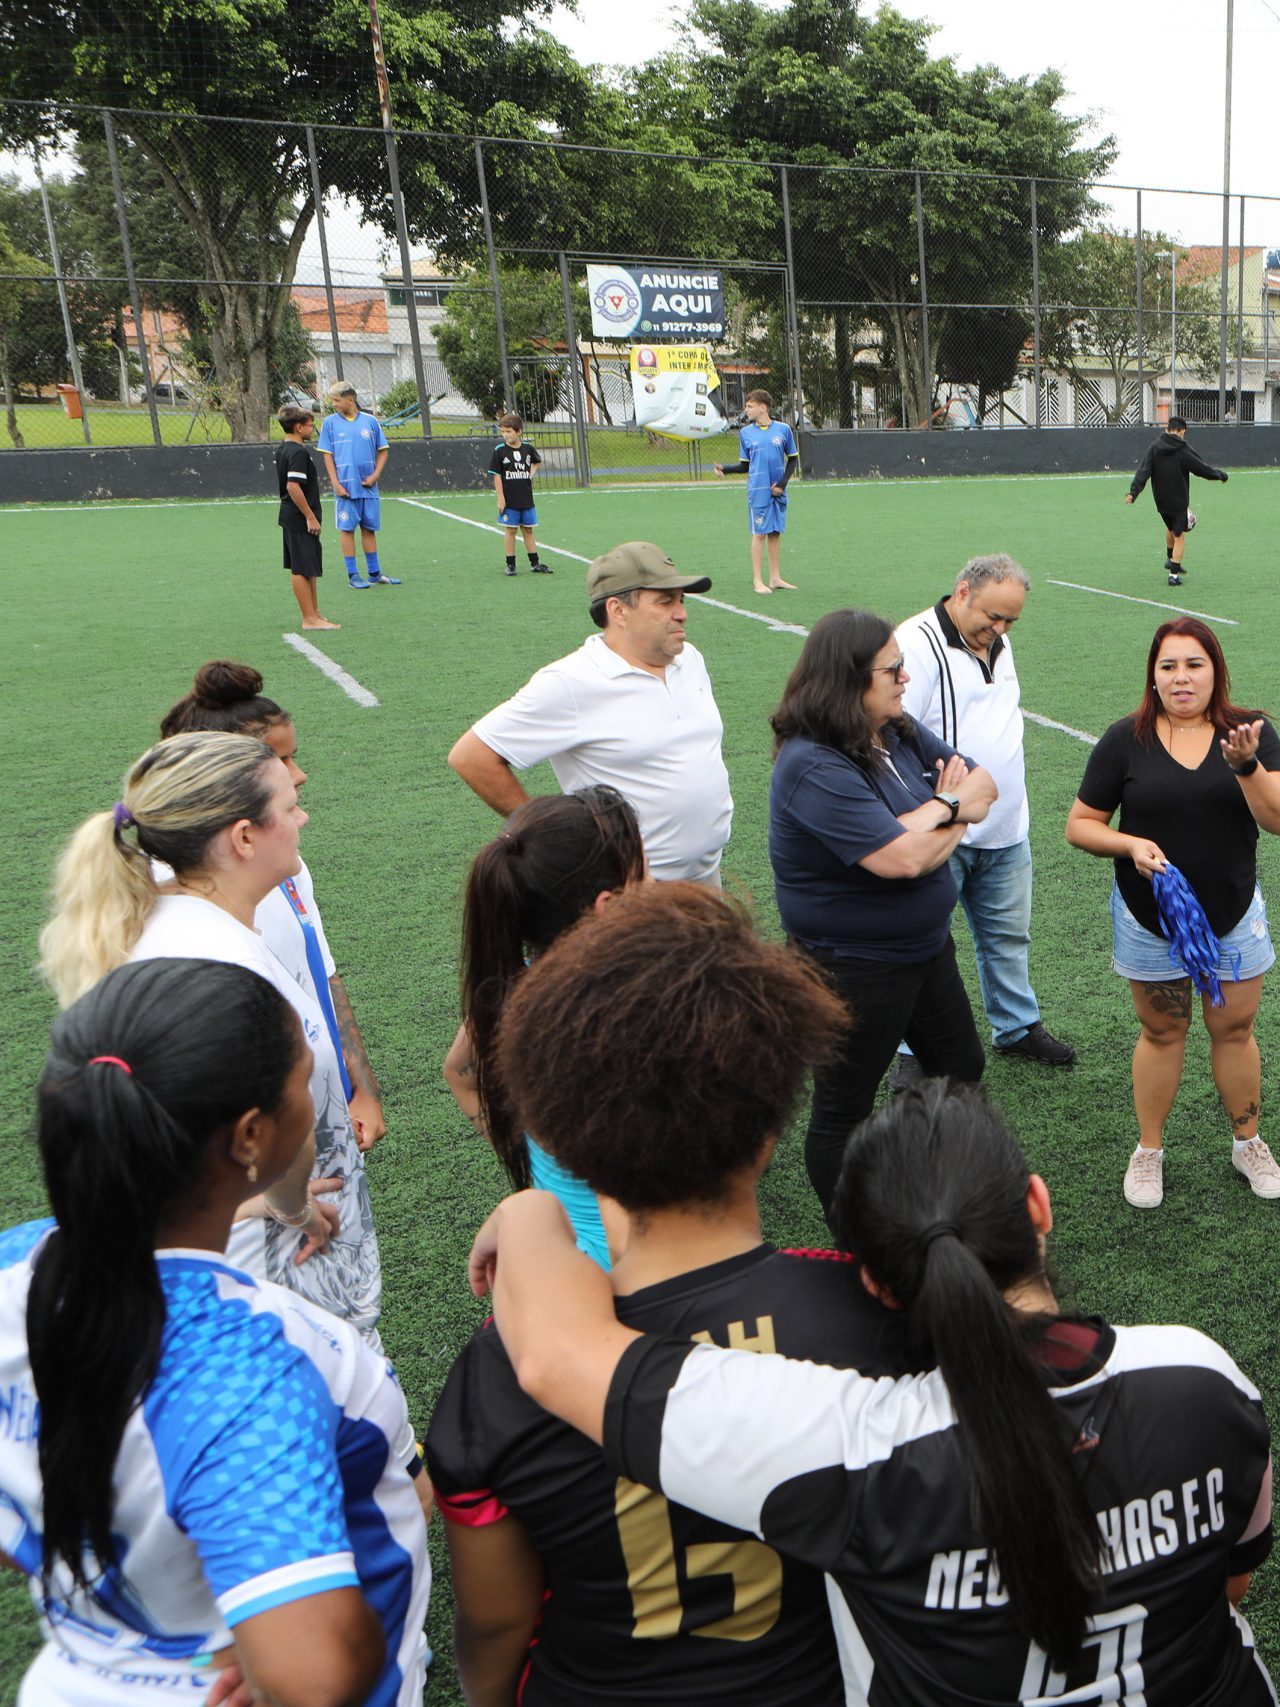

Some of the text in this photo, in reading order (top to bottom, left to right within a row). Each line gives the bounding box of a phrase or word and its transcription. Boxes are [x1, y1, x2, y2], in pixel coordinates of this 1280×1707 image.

[640, 273, 719, 290] ANUNCIE
[651, 294, 713, 317] AQUI
[662, 322, 722, 333] 91277-3969
[678, 351, 698, 359] COPA
[669, 361, 692, 370] INTER
[1182, 1467, 1225, 1546] F.C
